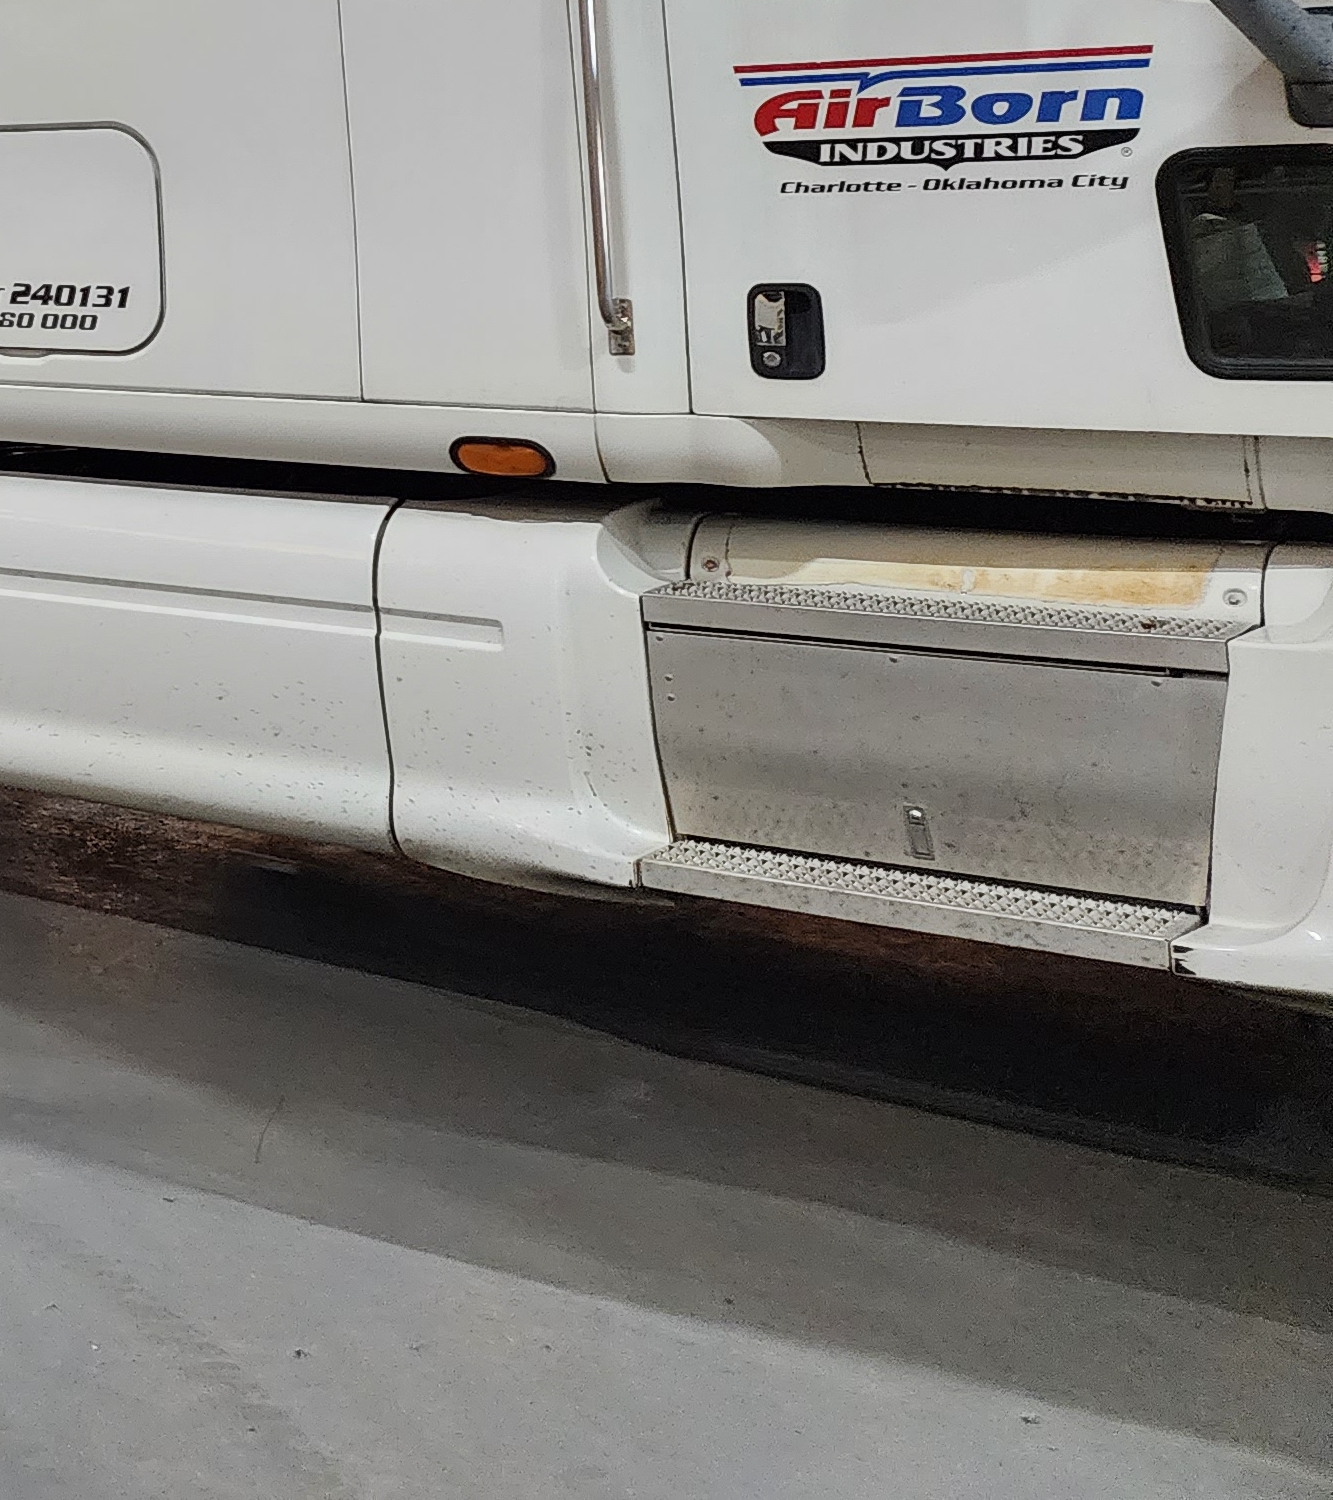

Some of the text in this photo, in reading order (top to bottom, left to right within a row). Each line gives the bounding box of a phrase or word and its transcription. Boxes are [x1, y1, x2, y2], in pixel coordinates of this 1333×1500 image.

[754, 85, 1144, 137] AirBorn
[819, 135, 1084, 163] INDUSTRIES
[780, 181, 902, 194] Charlotte
[923, 177, 1064, 190] Oklahoma
[1071, 174, 1129, 190] City
[9, 282, 131, 309] 240131
[40, 313, 99, 331] 000
